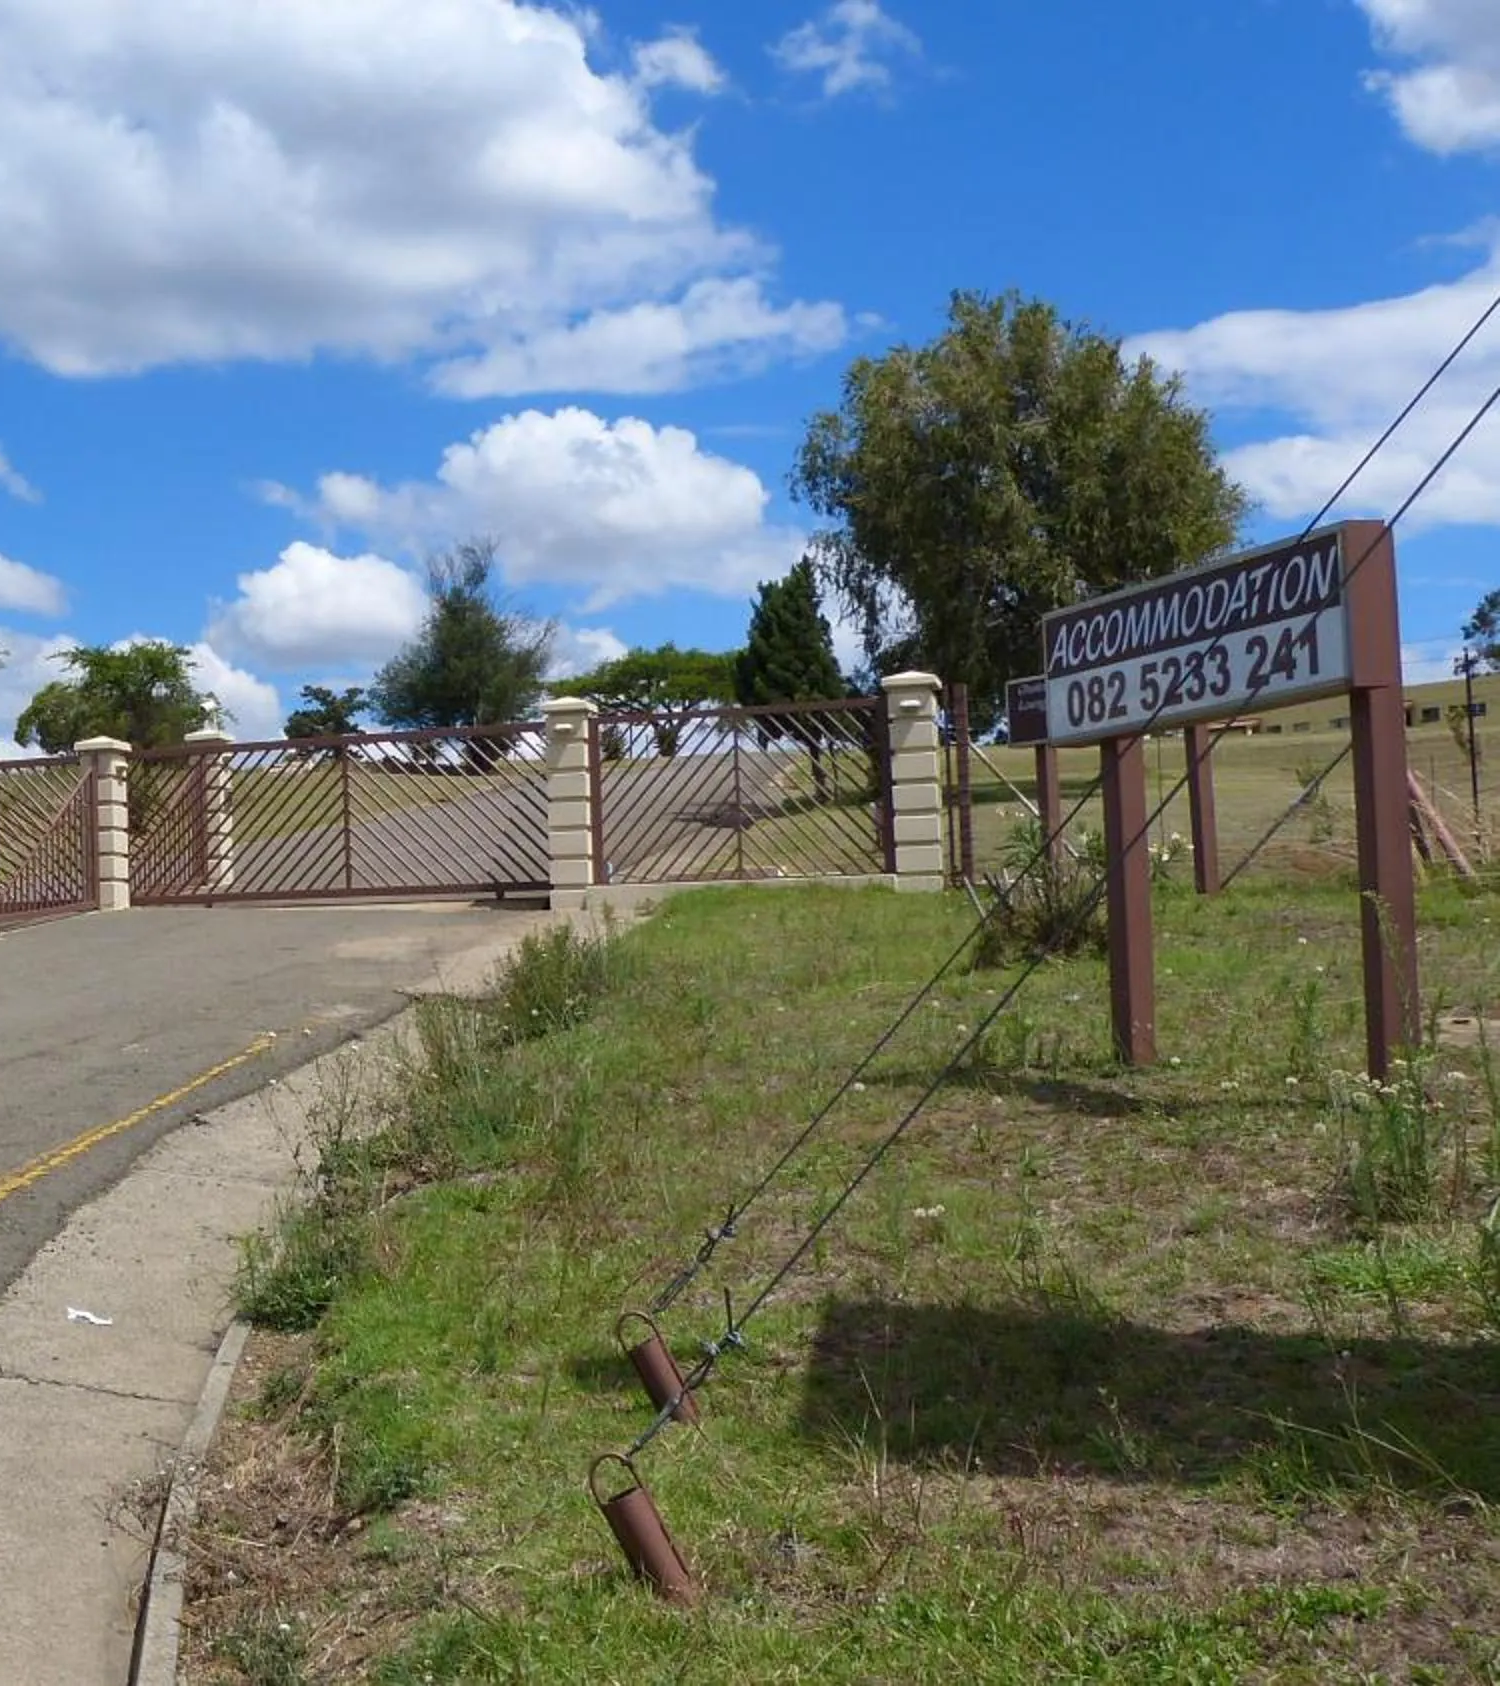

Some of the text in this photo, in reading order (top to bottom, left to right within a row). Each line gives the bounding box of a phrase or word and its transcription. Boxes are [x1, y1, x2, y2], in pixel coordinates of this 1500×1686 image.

[1048, 546, 1336, 673] ACCOMMODATION
[1067, 671, 1128, 728] 082
[1140, 645, 1231, 713] 5233
[1245, 618, 1320, 691] 241
